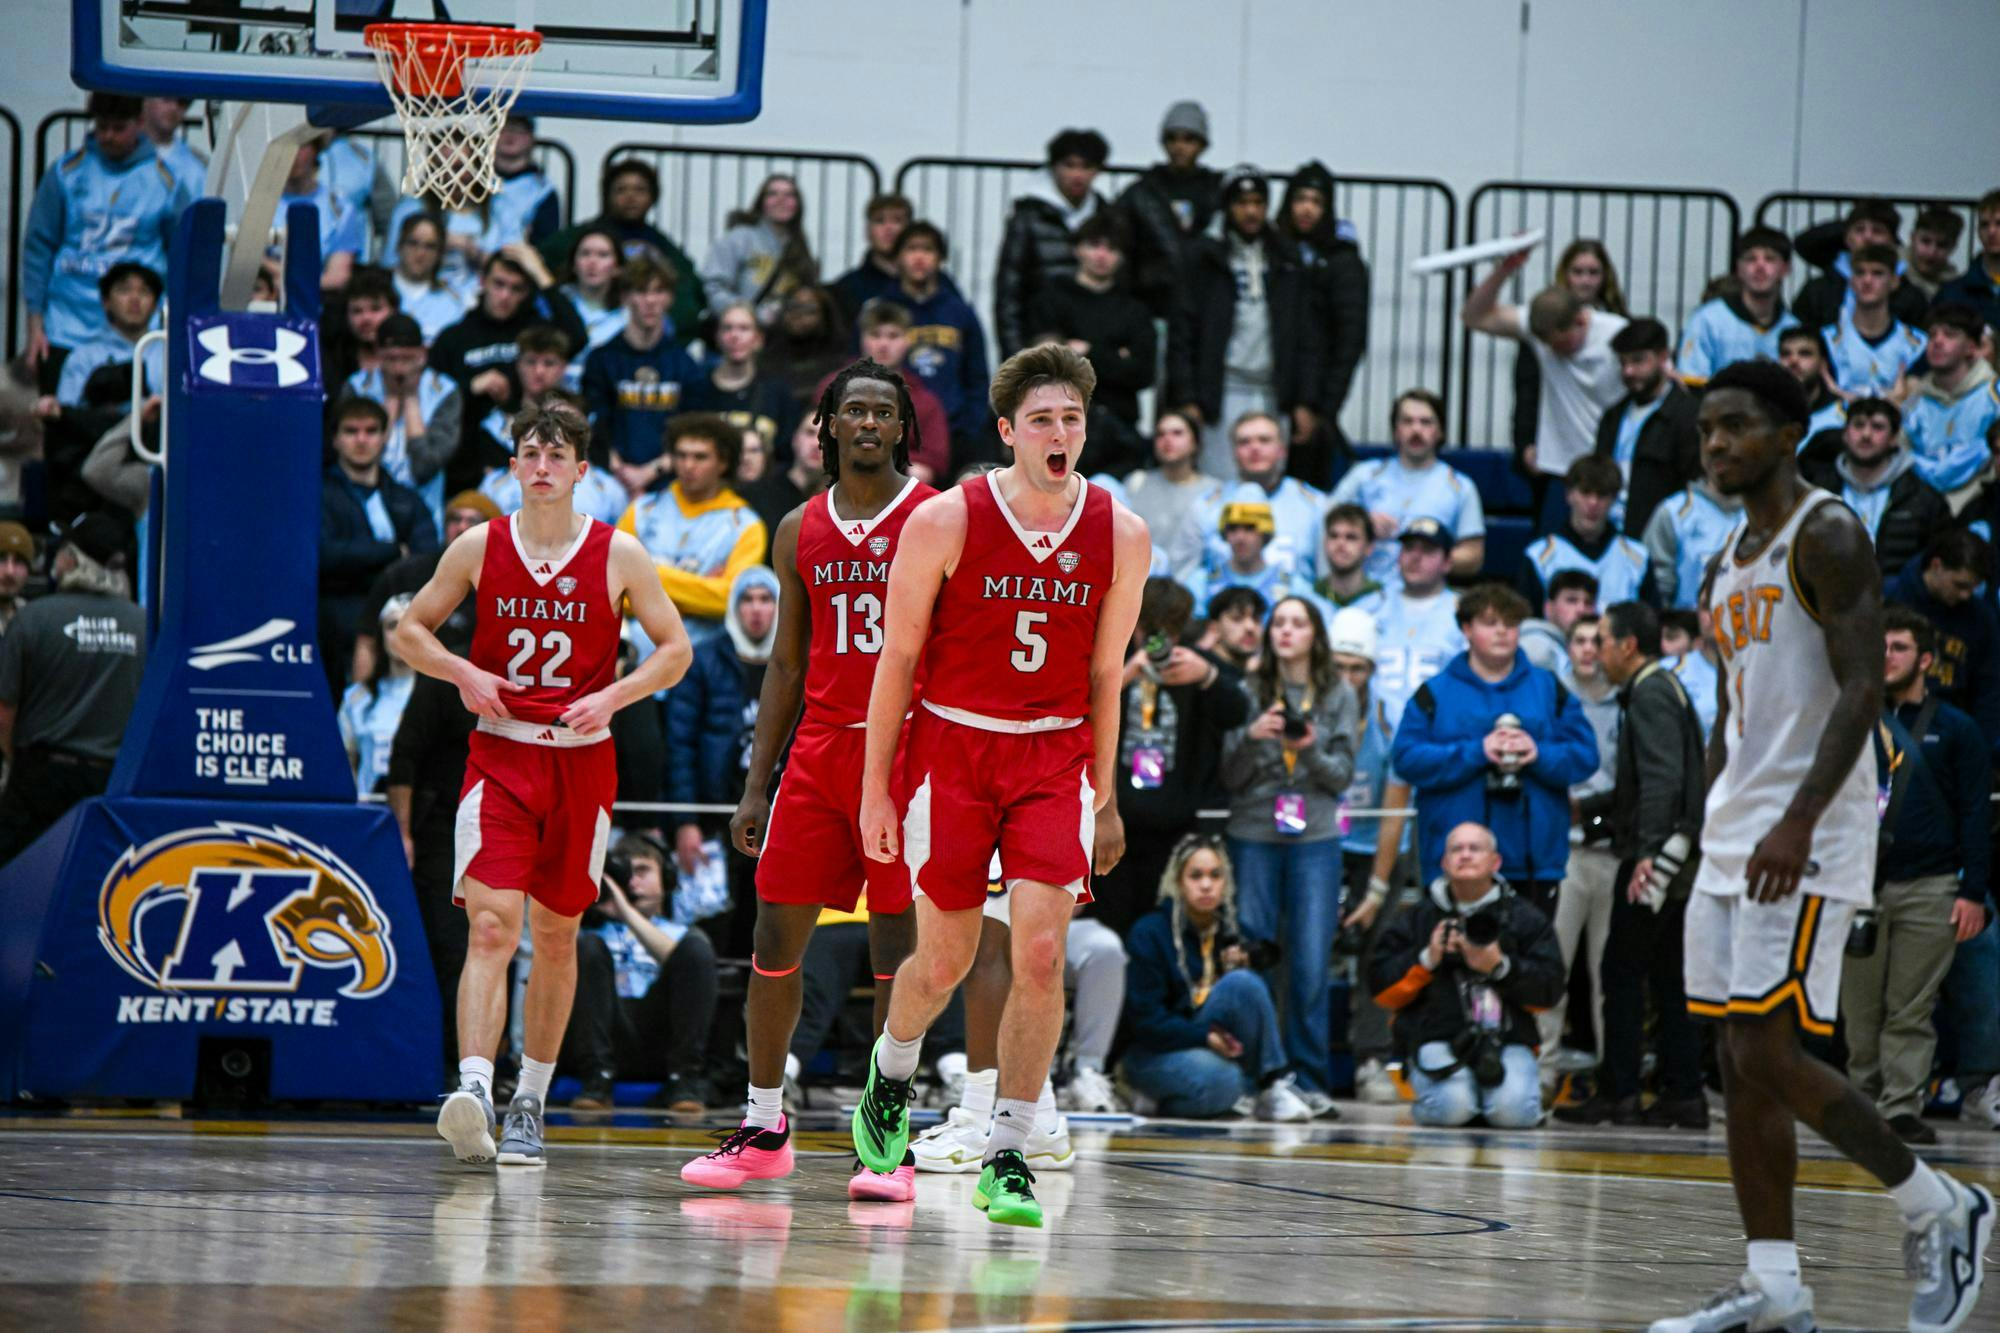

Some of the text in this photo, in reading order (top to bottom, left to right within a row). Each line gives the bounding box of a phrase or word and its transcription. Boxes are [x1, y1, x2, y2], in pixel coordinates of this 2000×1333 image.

[813, 561, 888, 585] MIAM
[983, 576, 1092, 606] MIAMI
[496, 597, 587, 622] MIAMI
[830, 592, 885, 654] 13
[270, 643, 313, 664] CLE
[1010, 610, 1048, 673] 5
[507, 628, 573, 688] 22
[196, 708, 244, 731] THE
[195, 732, 286, 756] CHOICE
[195, 755, 304, 780] IS CLEAR
[117, 996, 337, 1026] KENT STATE
